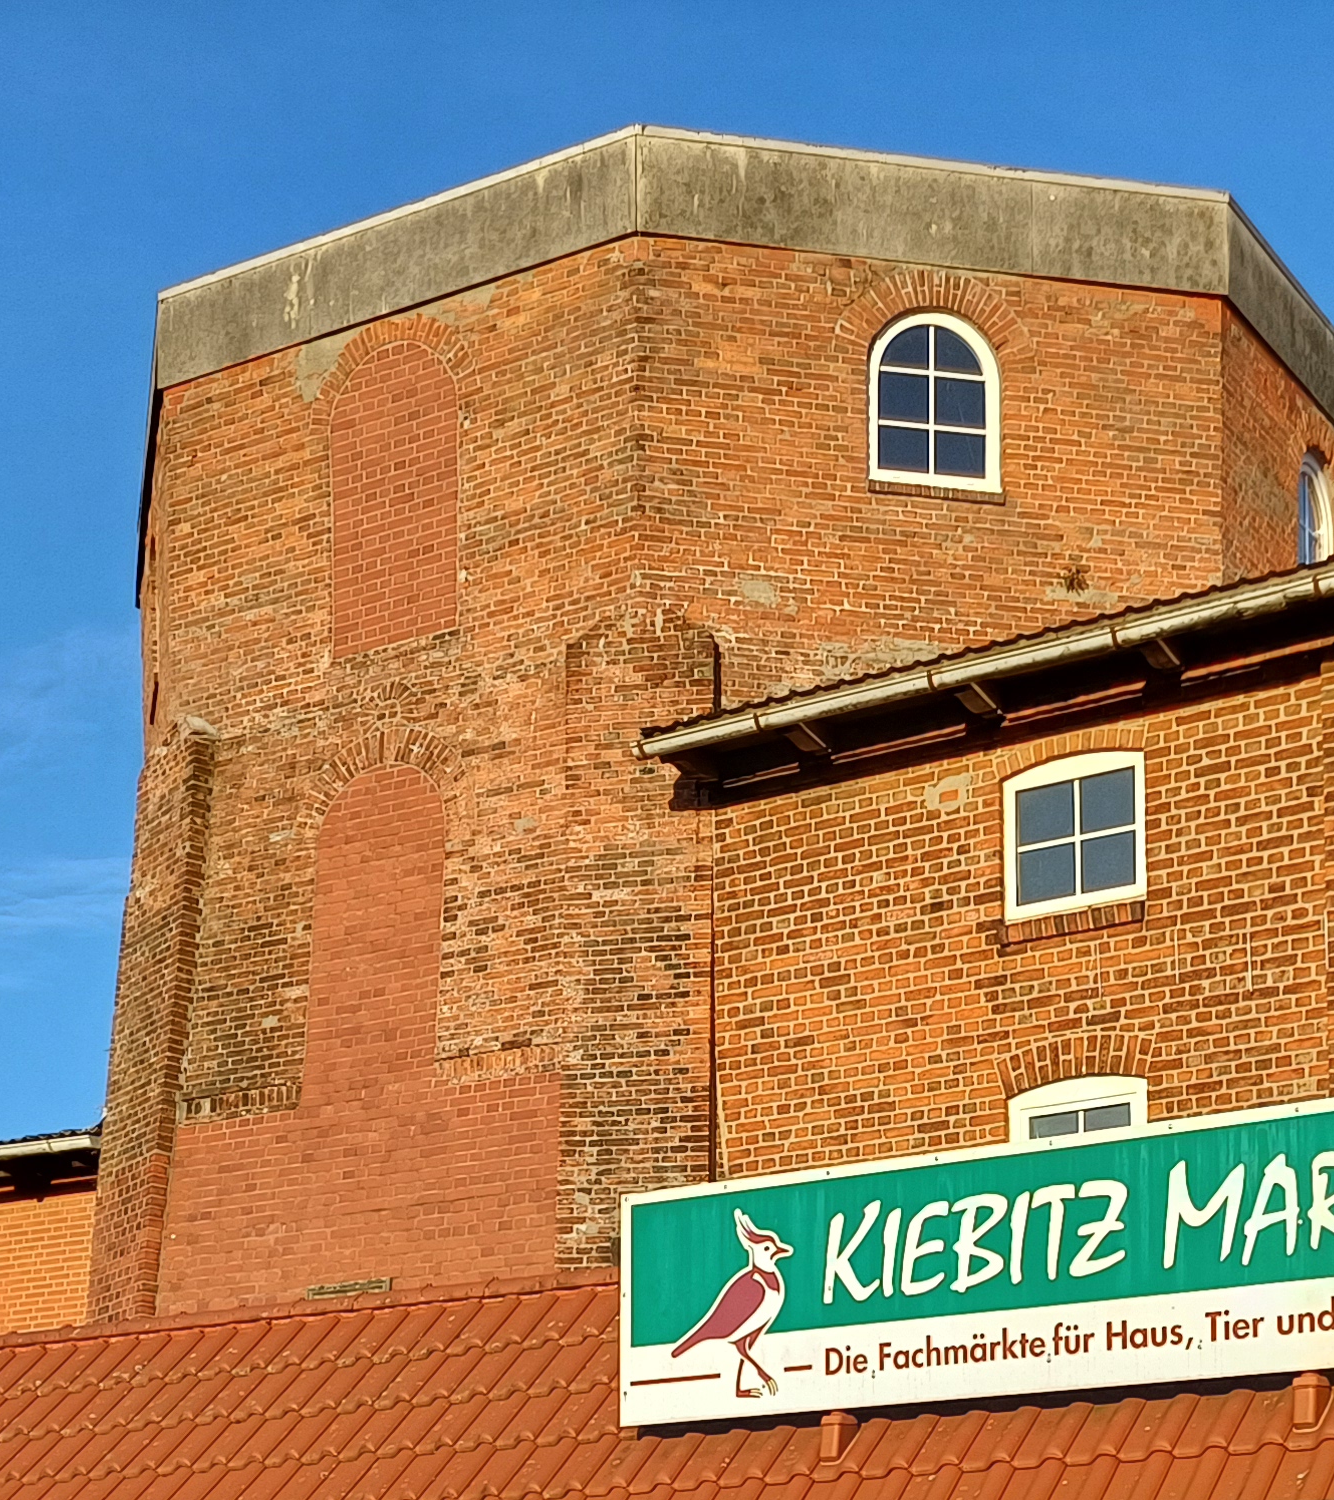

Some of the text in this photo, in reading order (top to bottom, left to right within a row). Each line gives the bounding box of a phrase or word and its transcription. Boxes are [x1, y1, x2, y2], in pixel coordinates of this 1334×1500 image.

[823, 1179, 1128, 1304] KIEBITZ
[825, 1345, 868, 1376] Die
[878, 1327, 1046, 1372] Fachmärkte
[1053, 1322, 1095, 1357] für
[1105, 1319, 1195, 1351] Haus,
[1205, 1309, 1265, 1343] Tier
